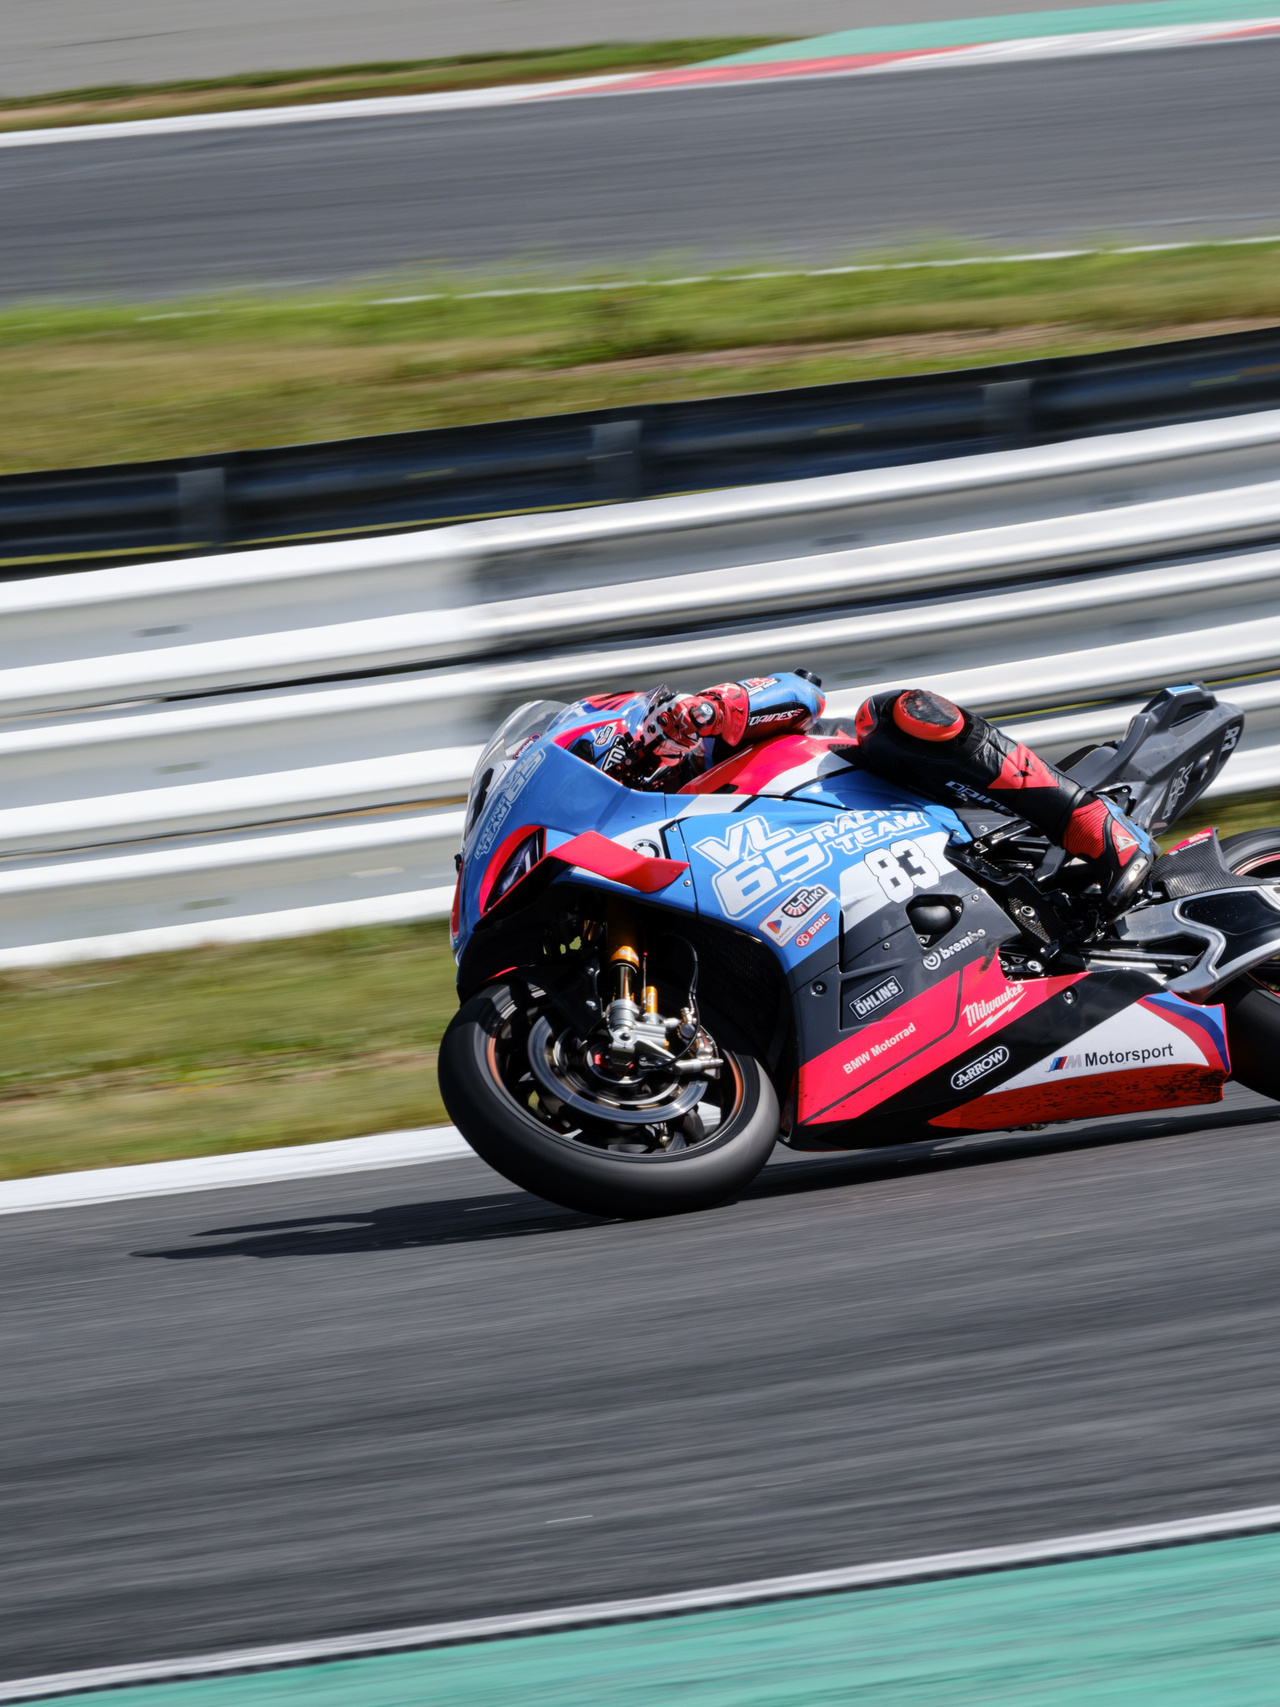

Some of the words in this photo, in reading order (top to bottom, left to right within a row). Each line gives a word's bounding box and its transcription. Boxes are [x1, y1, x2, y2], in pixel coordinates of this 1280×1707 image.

[697, 818, 790, 867] VL
[834, 812, 922, 850] TEAM
[716, 833, 826, 916] 65
[864, 838, 941, 904] 83
[808, 913, 831, 935] BAIC
[940, 928, 986, 960] brembo
[855, 980, 900, 1015] ÖHLINS
[961, 984, 1024, 1027] Milwaukee
[842, 1050, 871, 1075] BMW
[870, 1022, 917, 1057] Motorrad
[956, 1048, 1004, 1086] ARROW
[1085, 1043, 1174, 1067] Motorsport
